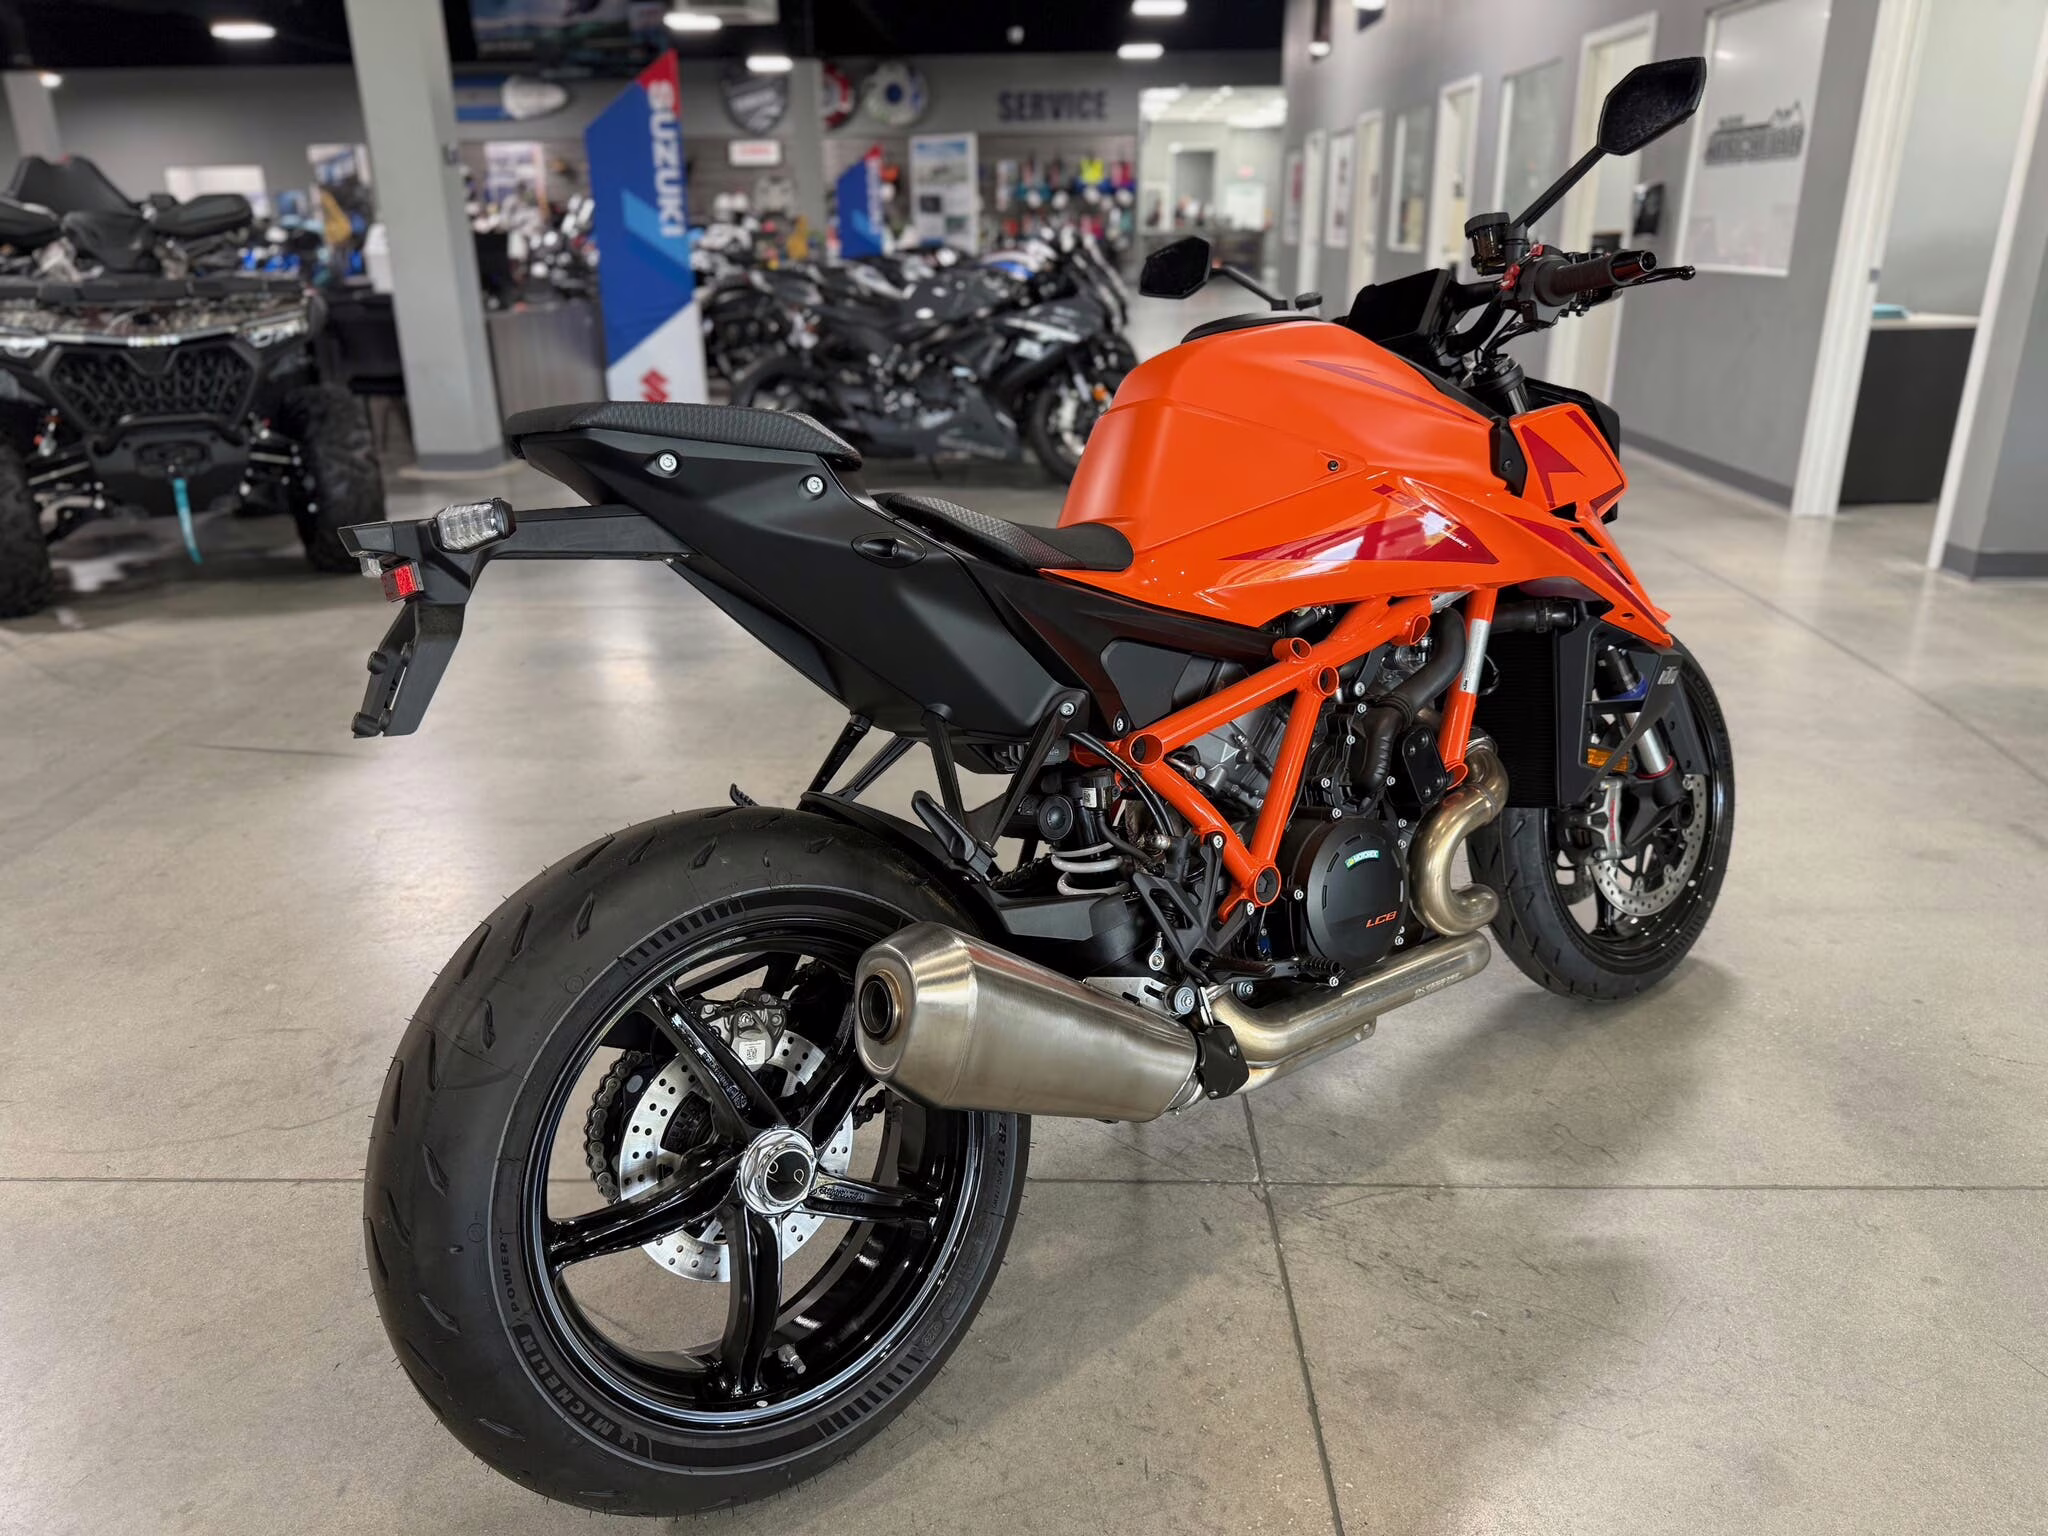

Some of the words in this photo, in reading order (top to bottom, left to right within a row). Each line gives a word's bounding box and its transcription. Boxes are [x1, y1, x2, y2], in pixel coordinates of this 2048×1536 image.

[998, 89, 1107, 121] SERVICE
[648, 79, 686, 238] SUZUKI
[499, 1242, 520, 1313] POWER
[520, 1335, 614, 1437] MICHELIN
